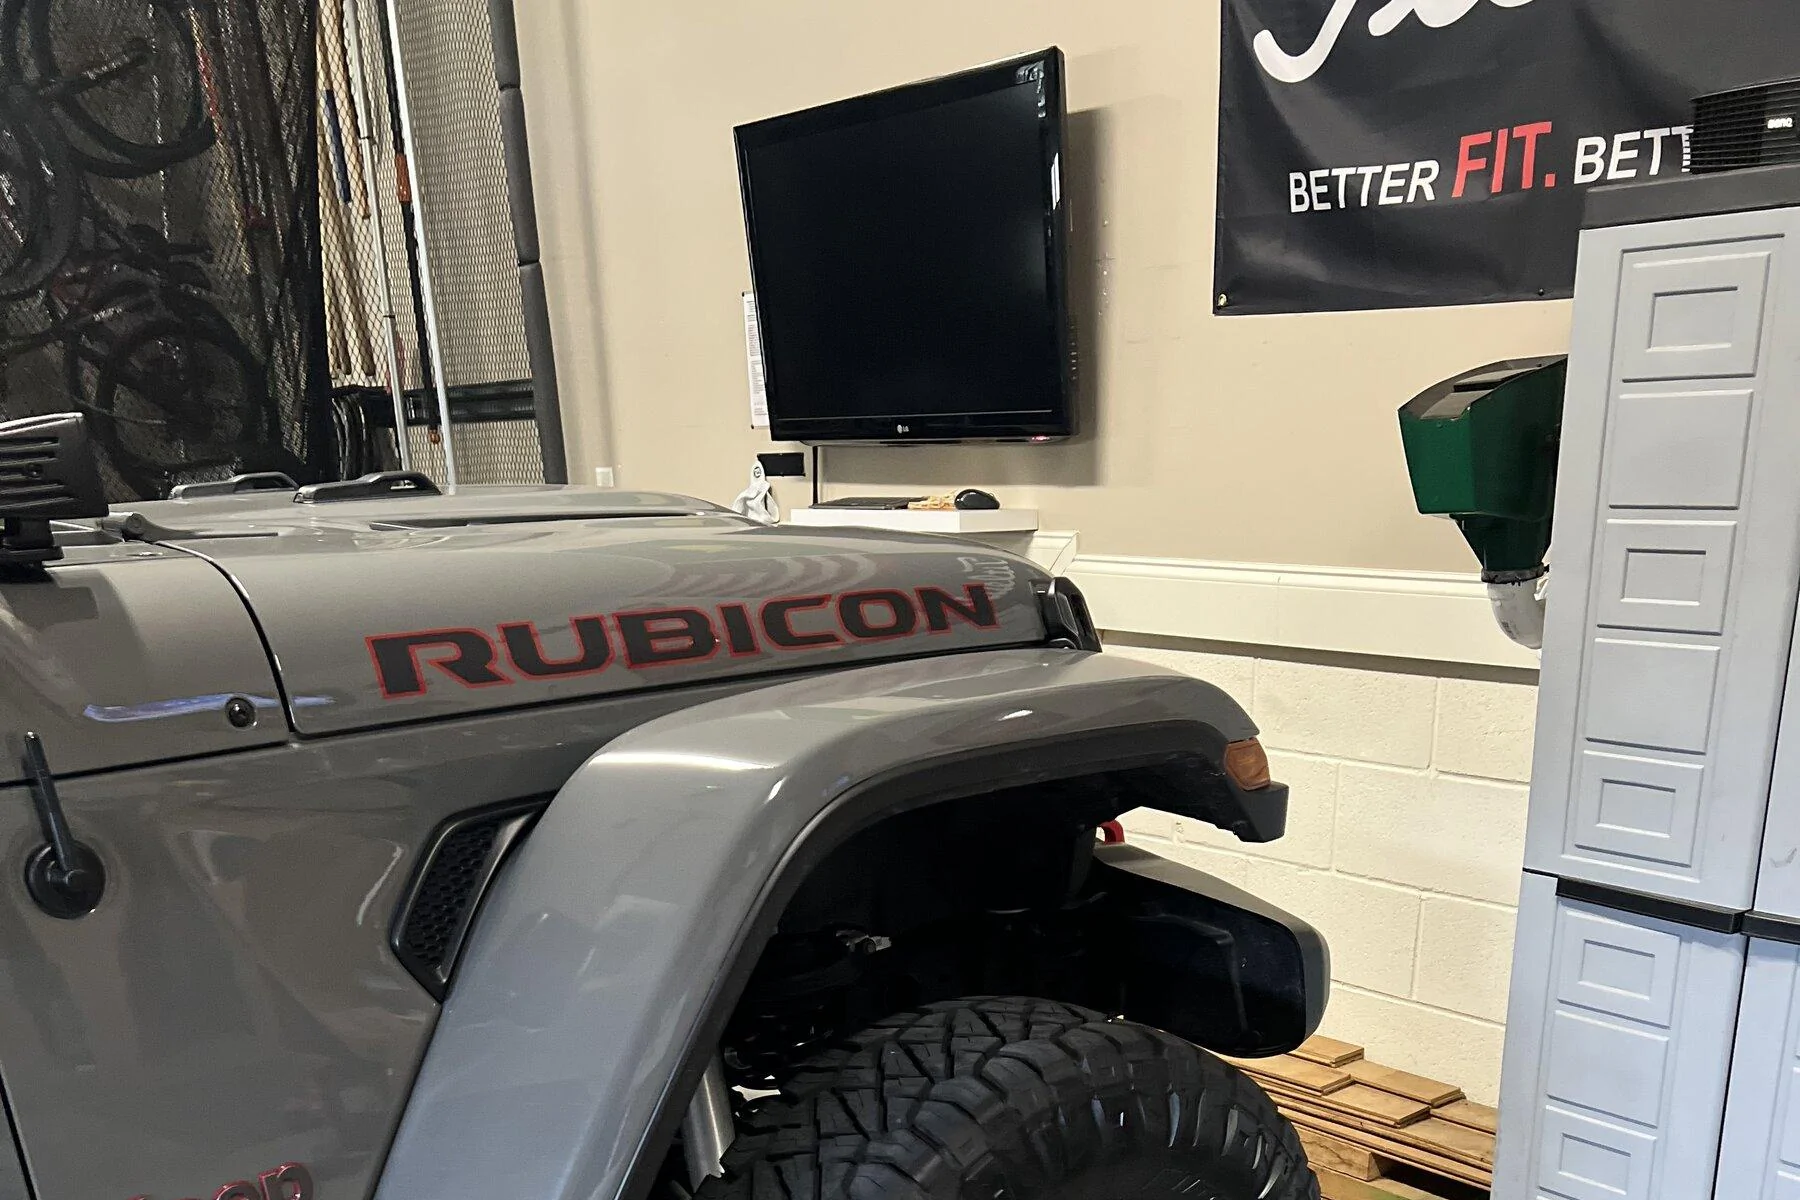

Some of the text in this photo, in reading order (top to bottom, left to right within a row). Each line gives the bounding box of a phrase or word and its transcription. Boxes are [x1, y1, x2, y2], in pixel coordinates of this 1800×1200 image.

[1289, 160, 1440, 212] BETTER
[1452, 121, 1556, 198] FIT.
[365, 583, 1001, 699] RUBICON
